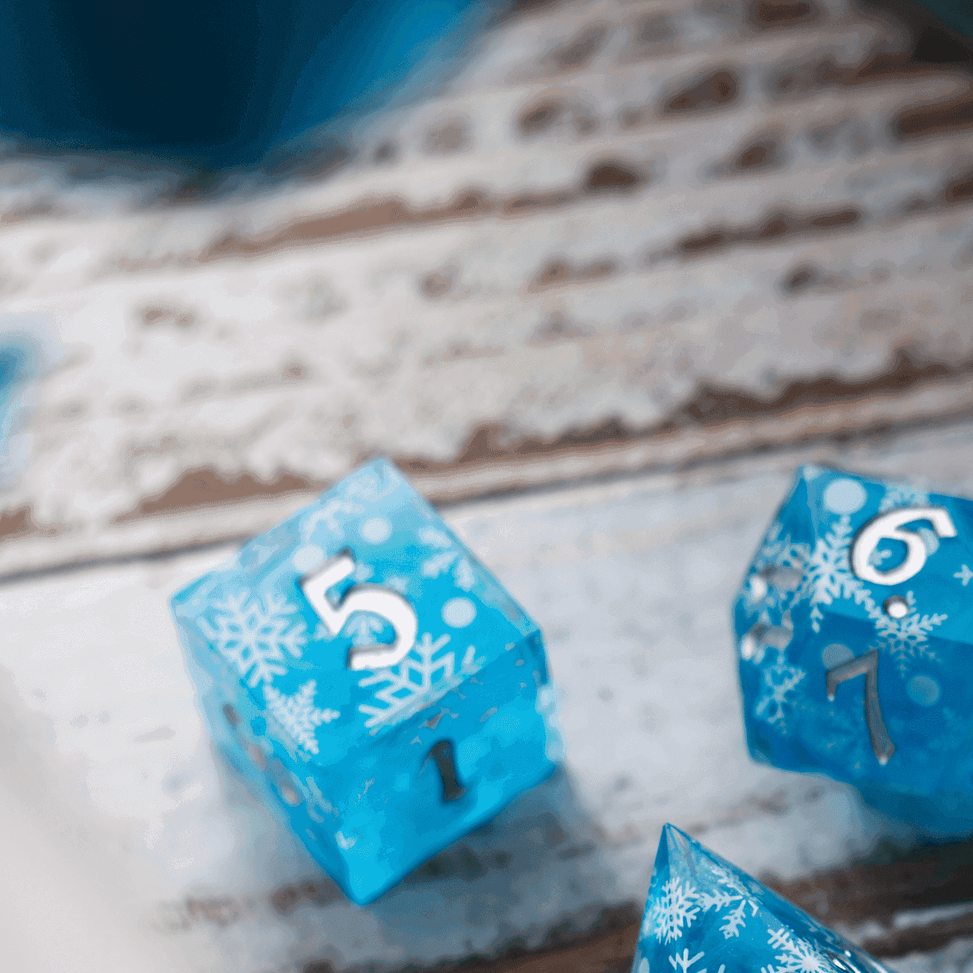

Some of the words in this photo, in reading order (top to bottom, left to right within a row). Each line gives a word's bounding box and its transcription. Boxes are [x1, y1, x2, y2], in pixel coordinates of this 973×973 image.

[299, 548, 418, 671] 5
[826, 650, 896, 765] 7
[423, 738, 468, 806] 1
